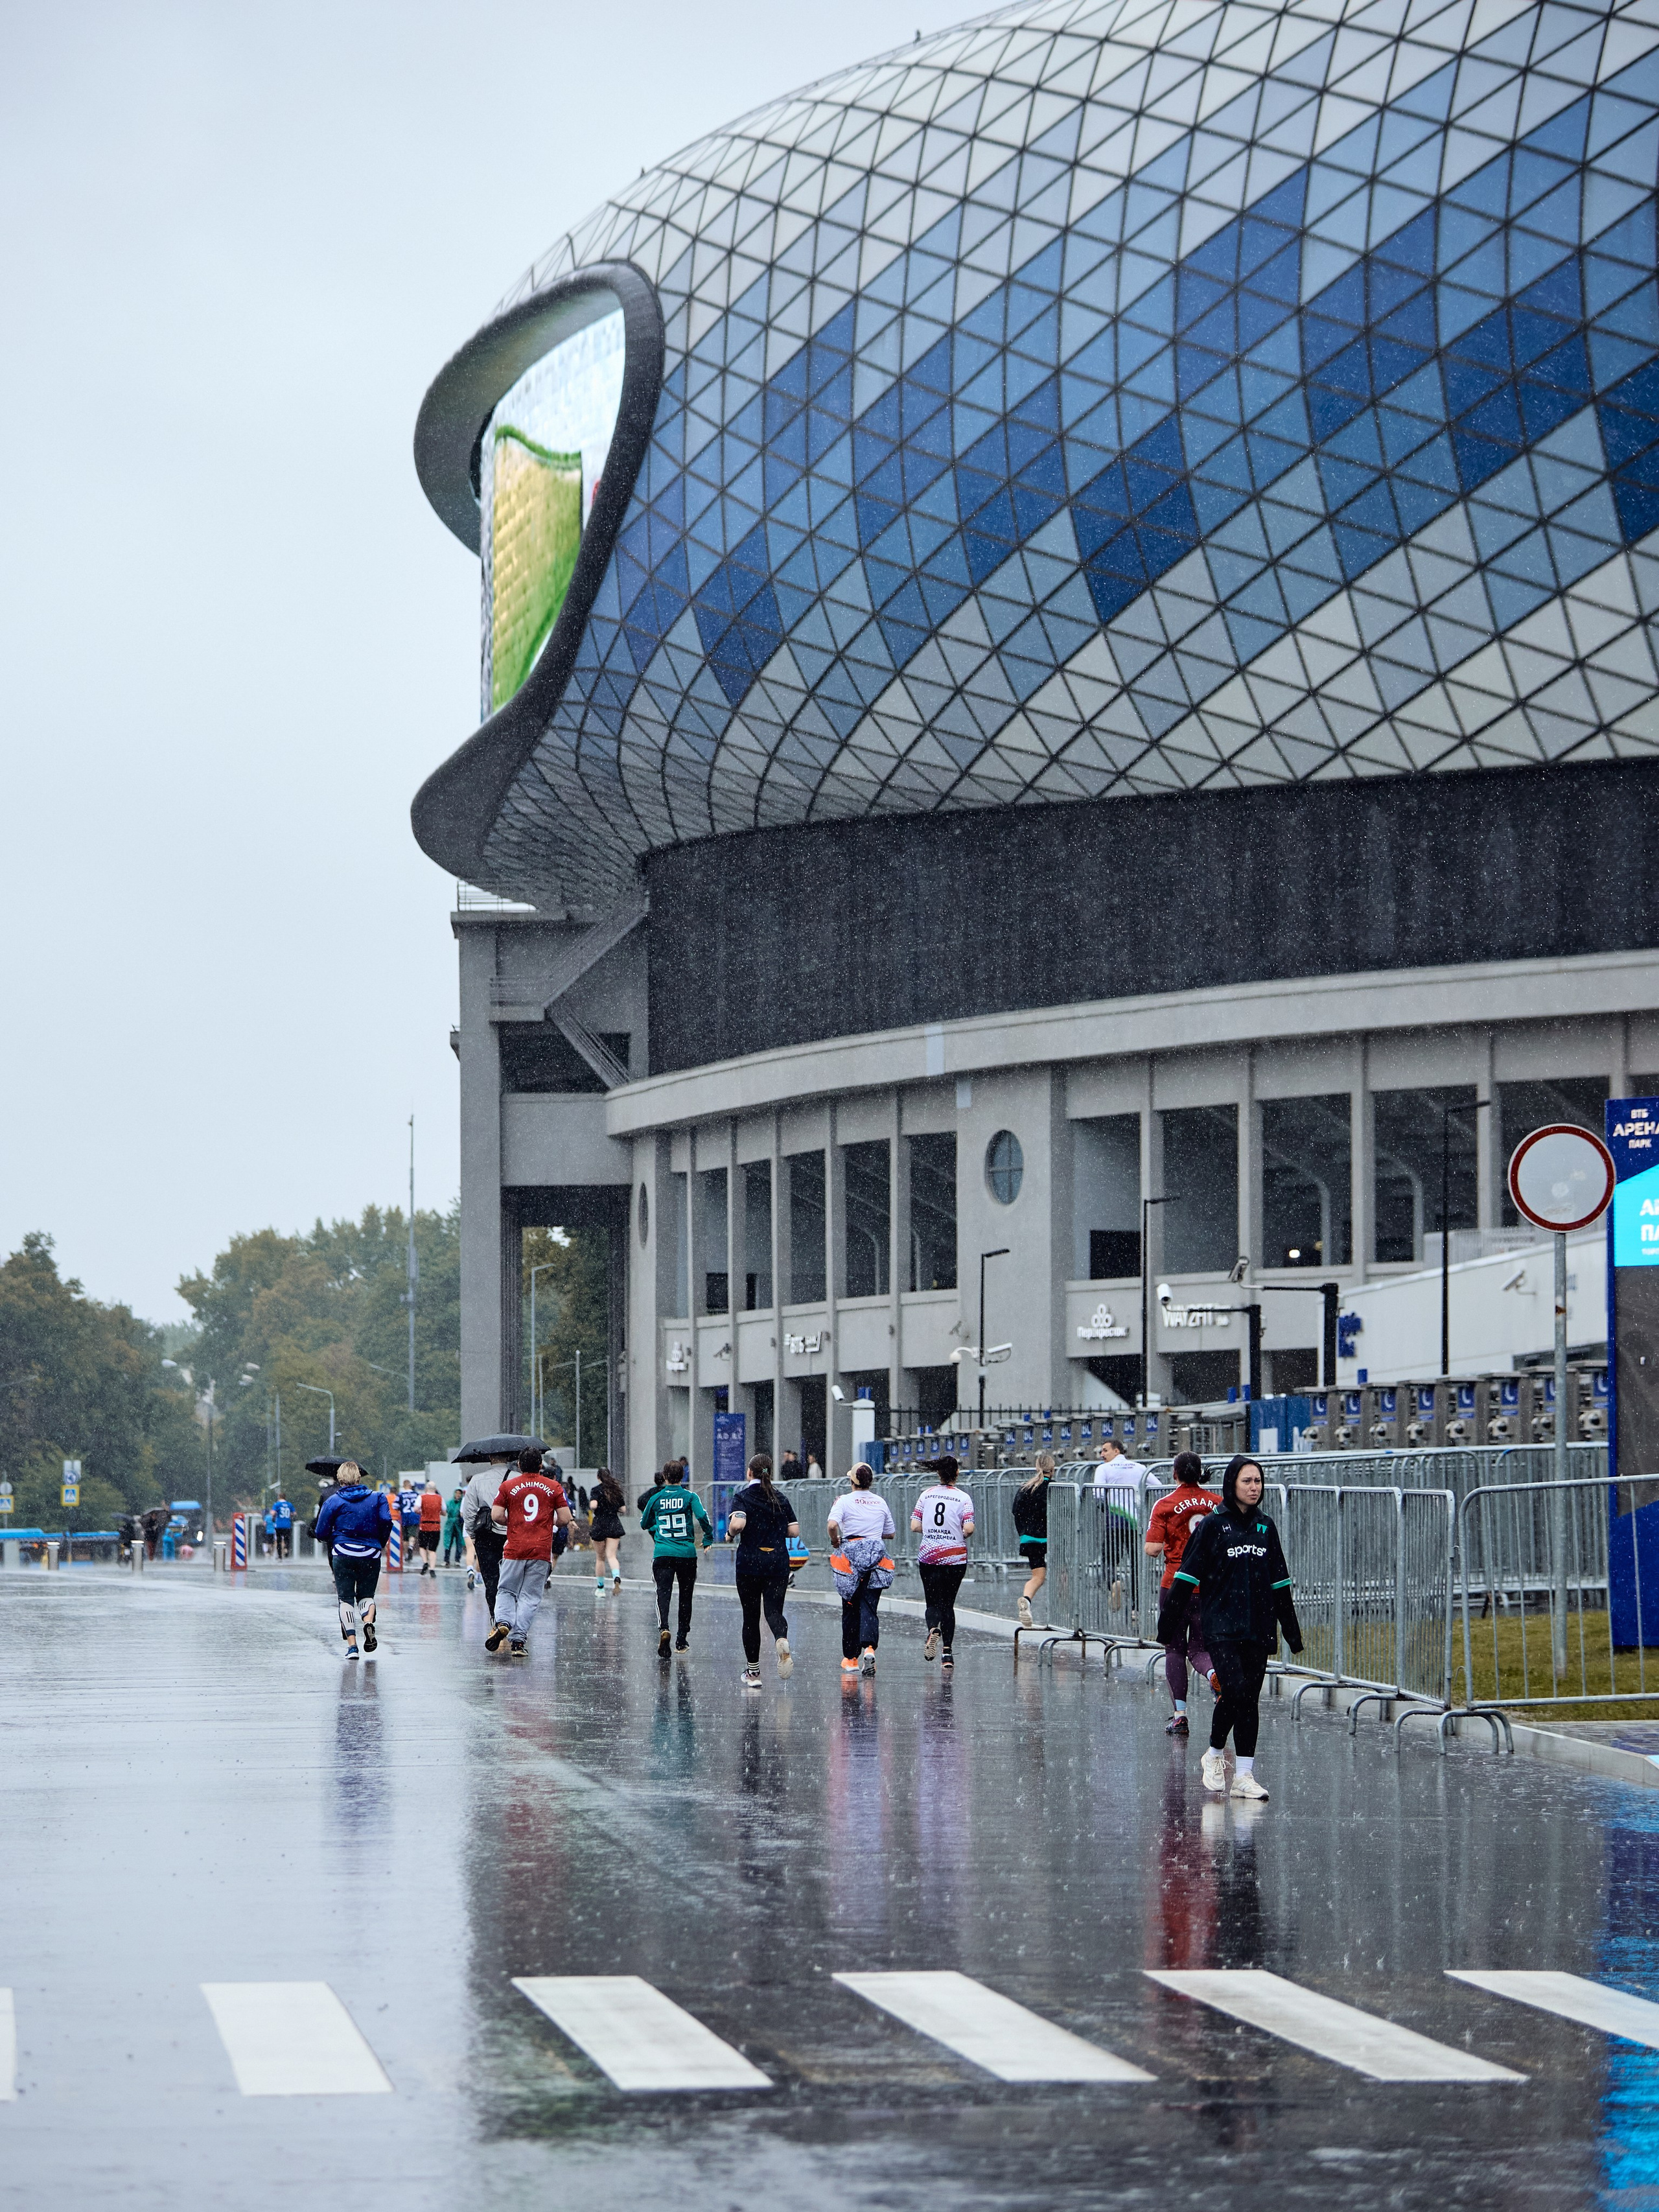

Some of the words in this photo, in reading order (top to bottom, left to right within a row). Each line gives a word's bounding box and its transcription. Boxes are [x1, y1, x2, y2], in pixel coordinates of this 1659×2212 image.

[1630, 1108, 1649, 1119] ВТБ
[1629, 1139, 1652, 1149] ПАРК
[509, 1481, 555, 1497] IBRAHIMOVIĆ
[279, 1506, 290, 1519] 30
[523, 1493, 539, 1522] 9
[934, 1502, 946, 1527] 8
[658, 1513, 688, 1538] 29
